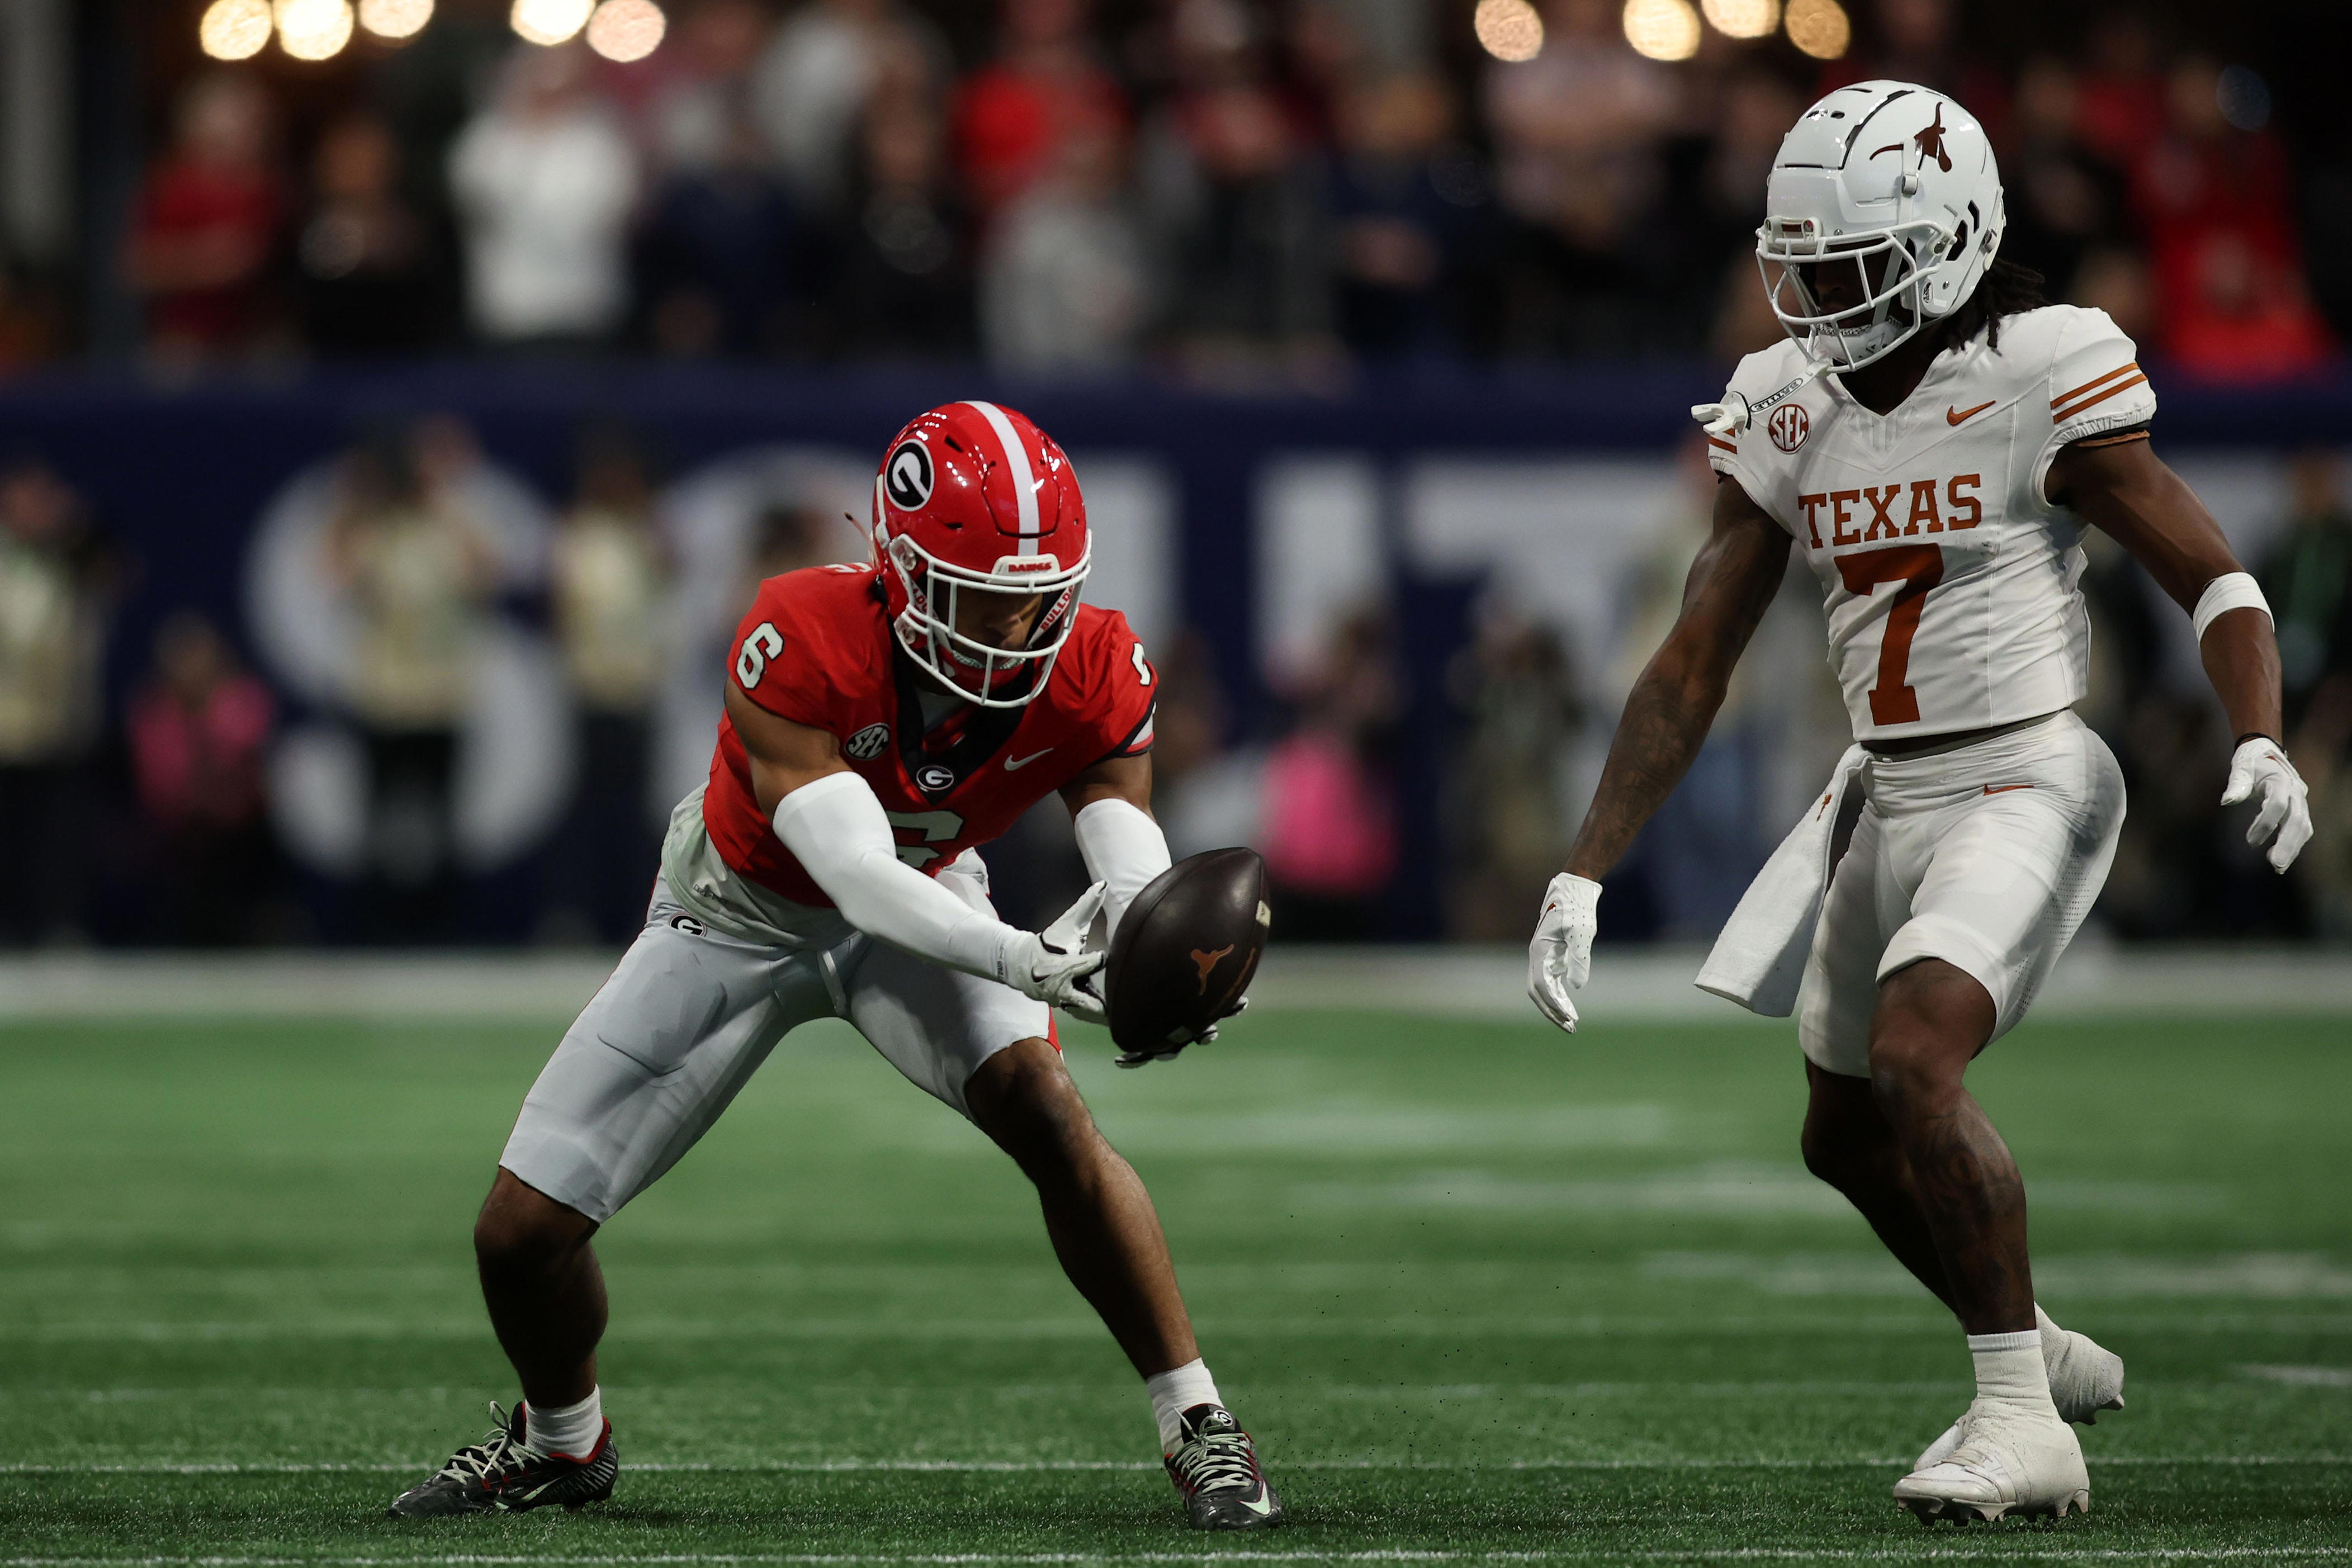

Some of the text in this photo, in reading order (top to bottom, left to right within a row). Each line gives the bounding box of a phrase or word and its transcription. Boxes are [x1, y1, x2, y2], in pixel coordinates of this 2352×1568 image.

[1771, 406, 1809, 450] SEC
[1798, 473, 1982, 549] TEXAS
[1008, 562, 1052, 572] DAWGS
[736, 622, 784, 690] 6
[1834, 543, 1945, 727] 7
[847, 725, 890, 759] SEC
